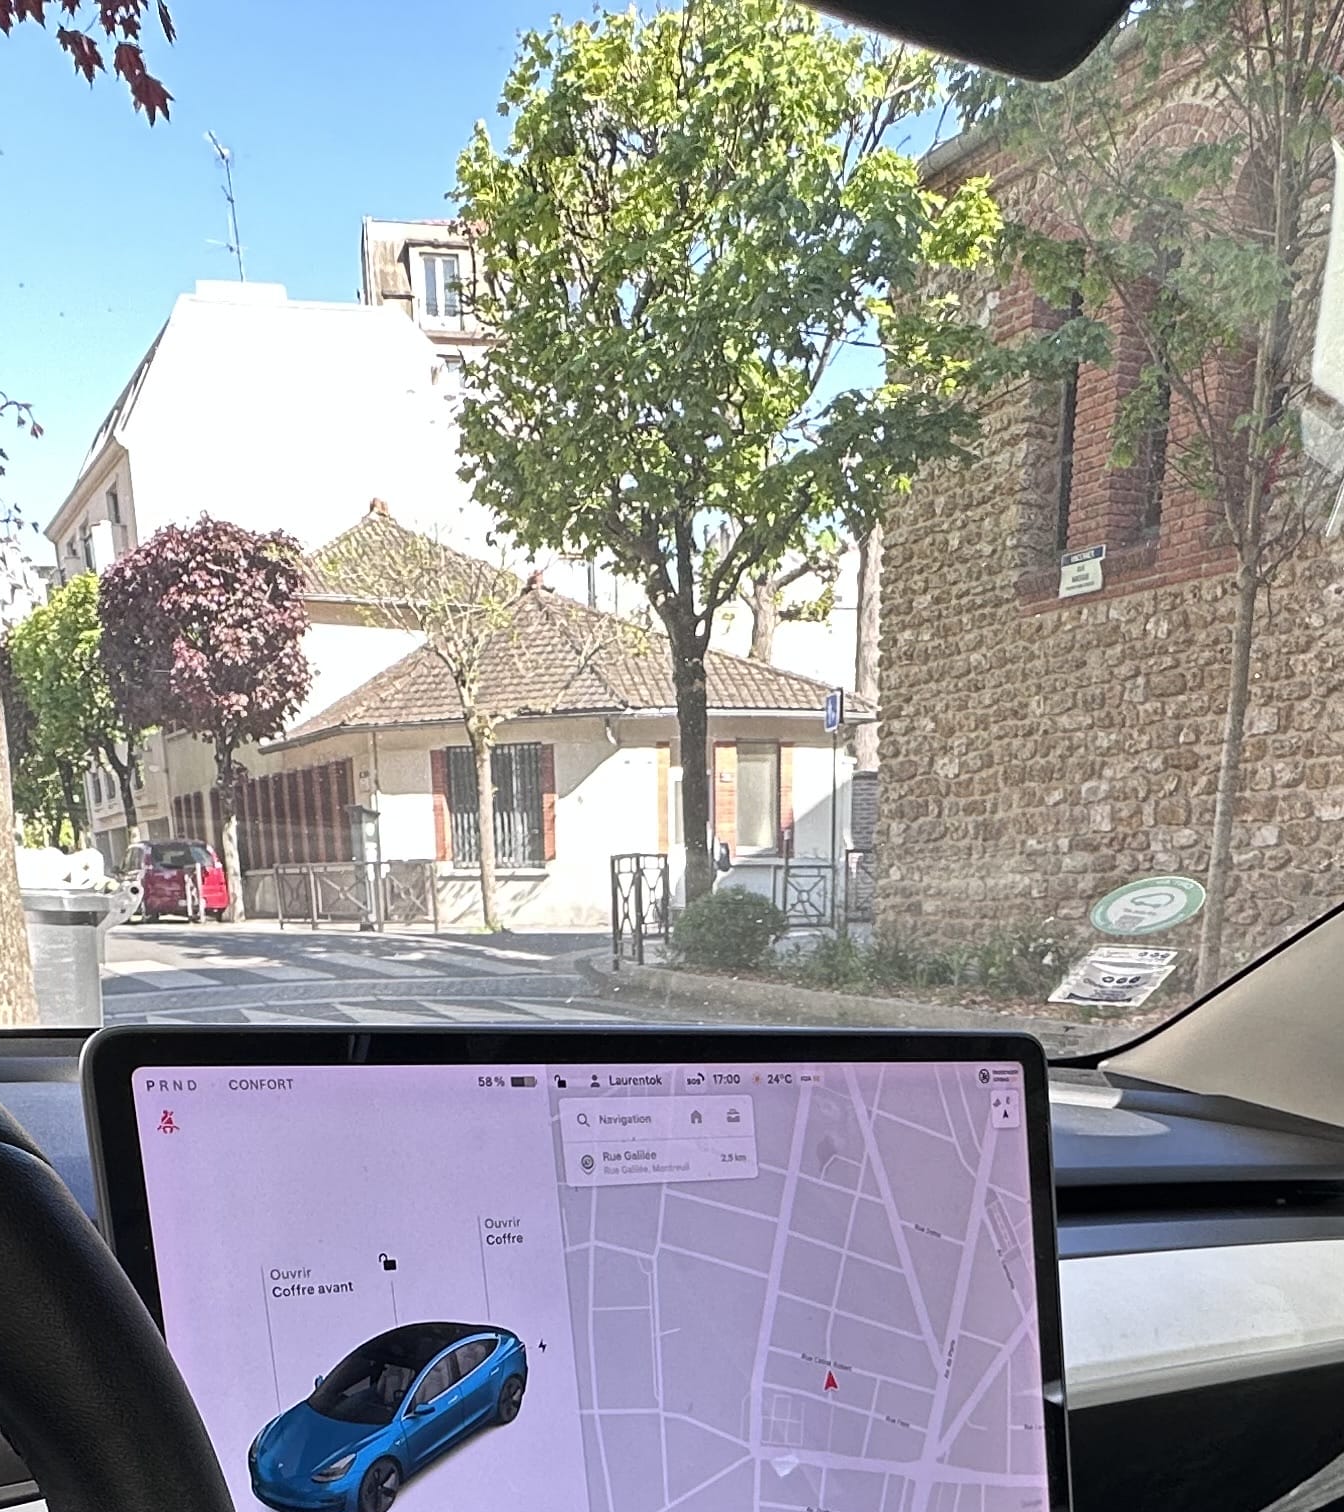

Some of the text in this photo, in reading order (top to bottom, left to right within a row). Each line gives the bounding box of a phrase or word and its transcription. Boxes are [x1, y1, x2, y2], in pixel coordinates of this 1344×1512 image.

[228, 1079, 294, 1091] CONFORT
[608, 1074, 663, 1087] Laurentok
[713, 1074, 741, 1085] 17:00
[599, 1115, 652, 1126] Navigation
[602, 1151, 622, 1161] Rue
[484, 1217, 521, 1230] Ouvrir
[486, 1233, 524, 1245] Coffre
[269, 1267, 312, 1281] Ouvrir
[272, 1281, 354, 1298] Coffre avant
